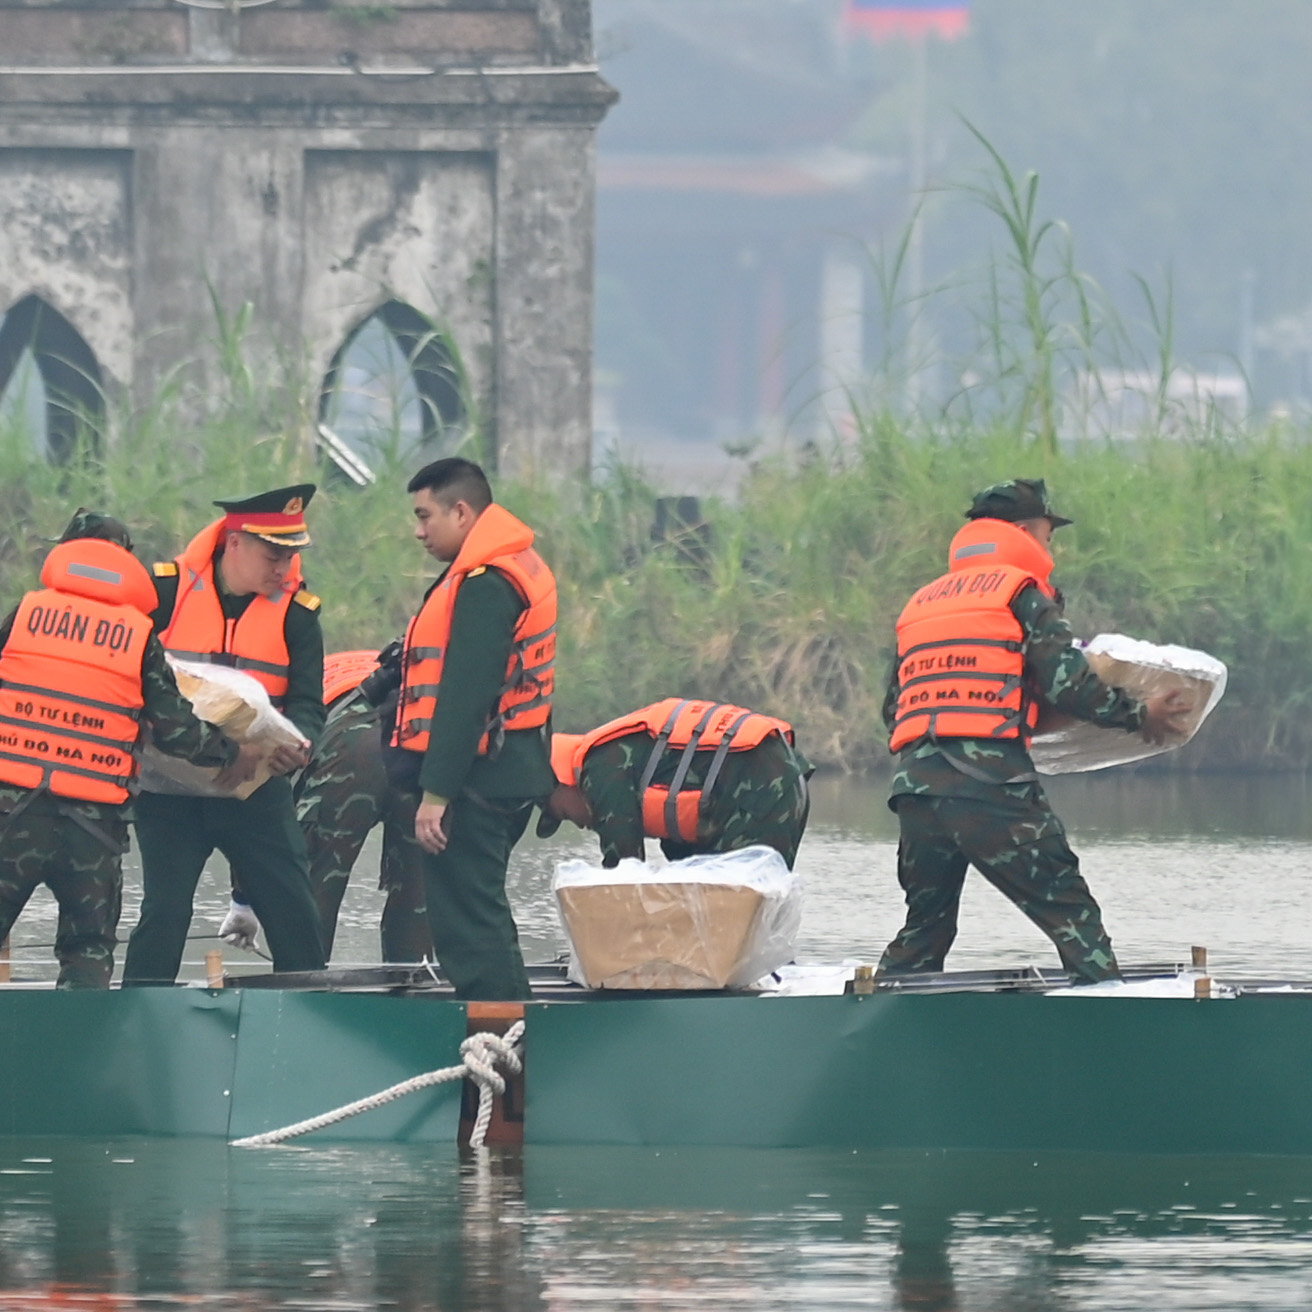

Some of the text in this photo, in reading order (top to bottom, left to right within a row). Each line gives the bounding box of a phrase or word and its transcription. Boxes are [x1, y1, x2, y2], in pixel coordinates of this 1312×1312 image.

[28, 605, 134, 657] QUÂN ĐỘI
[919, 657, 936, 670] TƯ
[938, 654, 977, 669] LỆNH
[15, 701, 104, 729] BỘ TƯ LỆNH
[91, 752, 122, 767] NỘI
